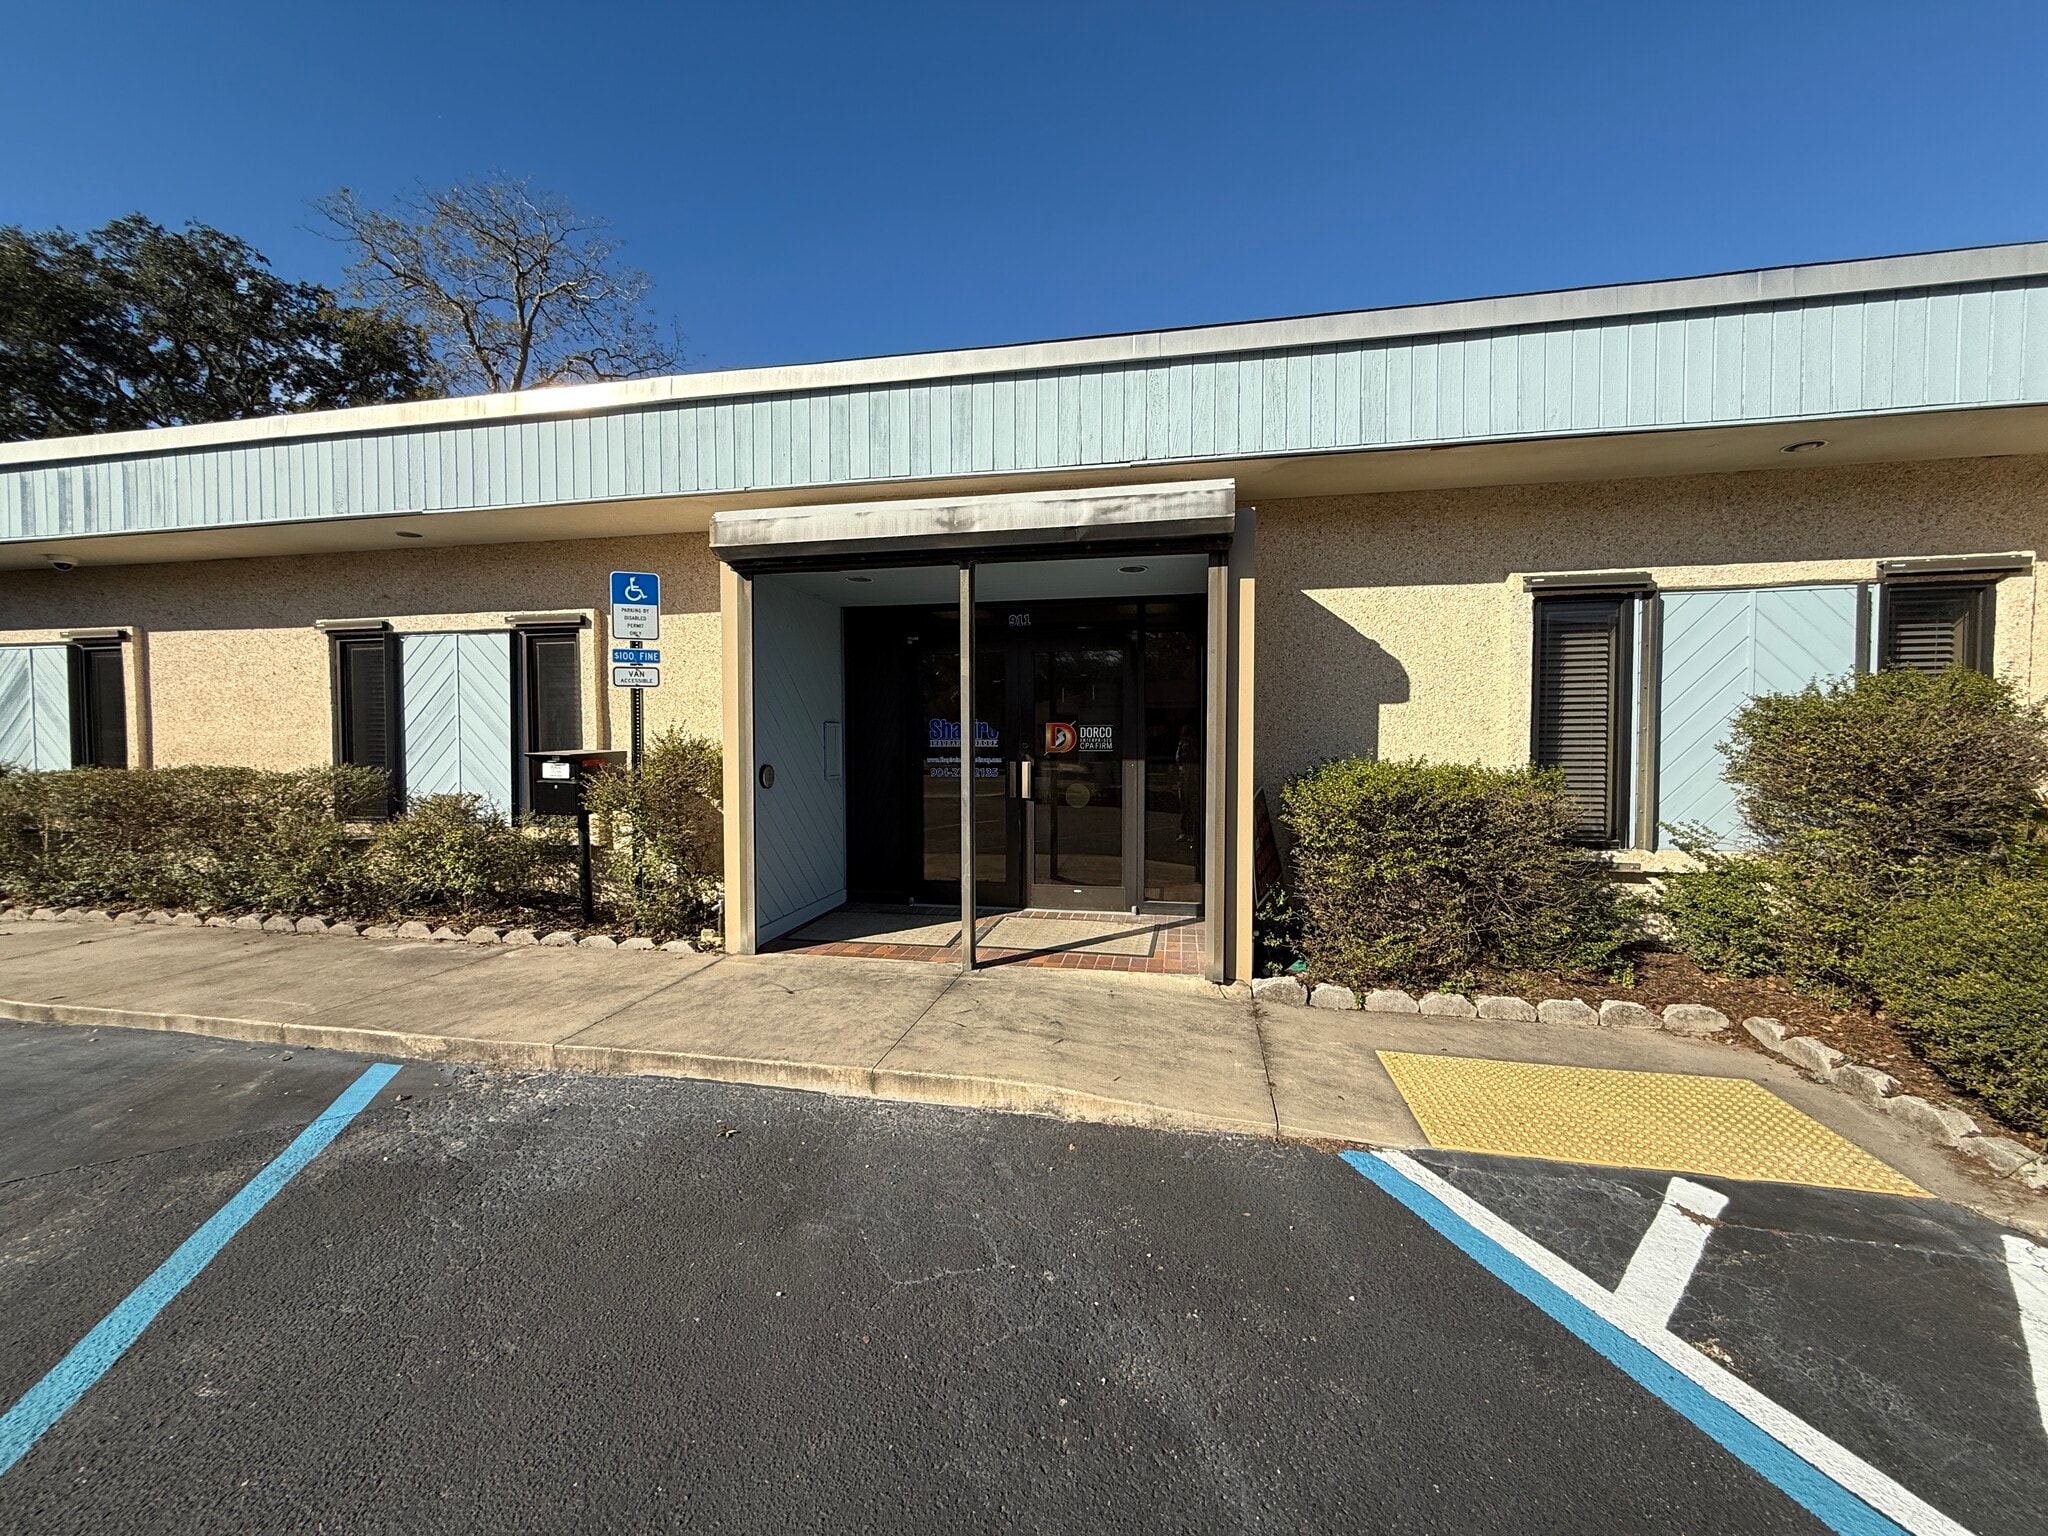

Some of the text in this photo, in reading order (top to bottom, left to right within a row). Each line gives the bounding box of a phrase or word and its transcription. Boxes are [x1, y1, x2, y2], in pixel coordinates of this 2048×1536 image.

[1008, 613, 1031, 627] 911
[639, 652, 658, 661] FINE
[929, 718, 999, 739] Shairo
[1079, 726, 1112, 738] DORCO
